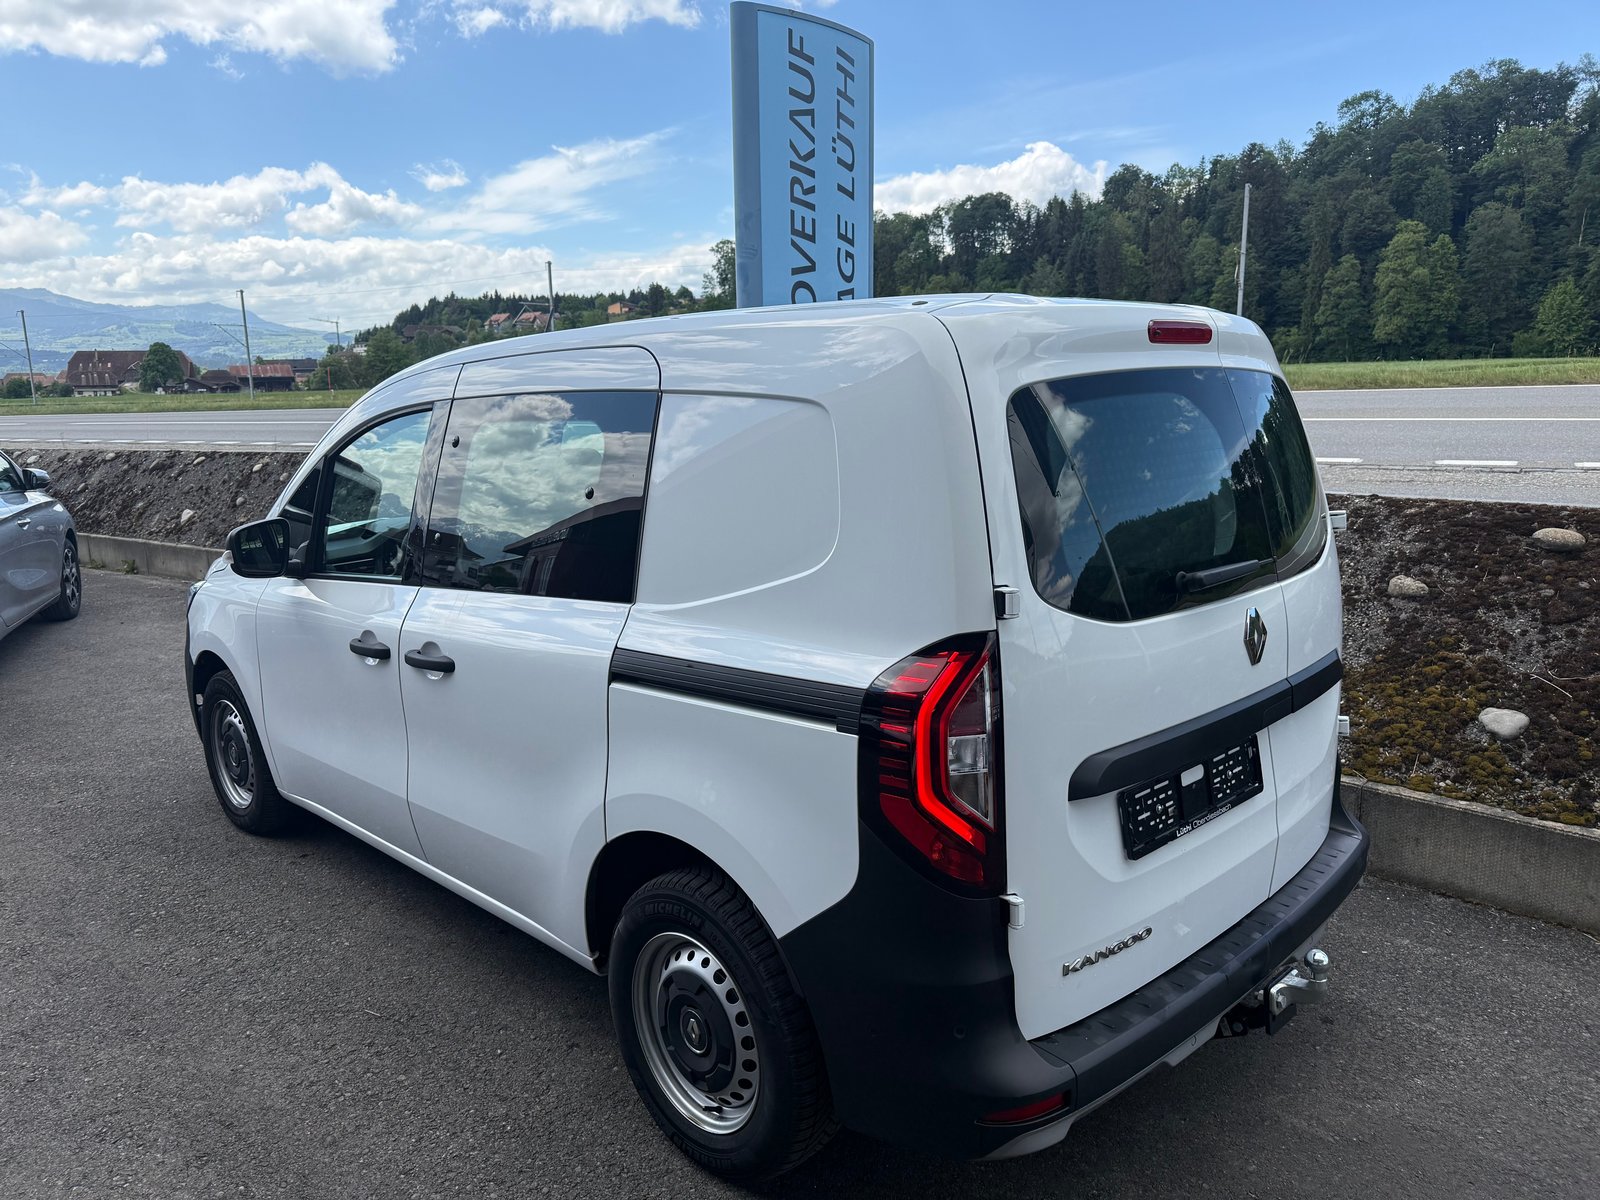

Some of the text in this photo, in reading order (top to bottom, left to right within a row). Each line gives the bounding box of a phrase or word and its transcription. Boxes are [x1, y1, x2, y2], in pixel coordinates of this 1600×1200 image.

[831, 46, 855, 201] LÜTHI
[644, 902, 703, 929] MICHELIN
[1062, 925, 1153, 977] KANGOO
